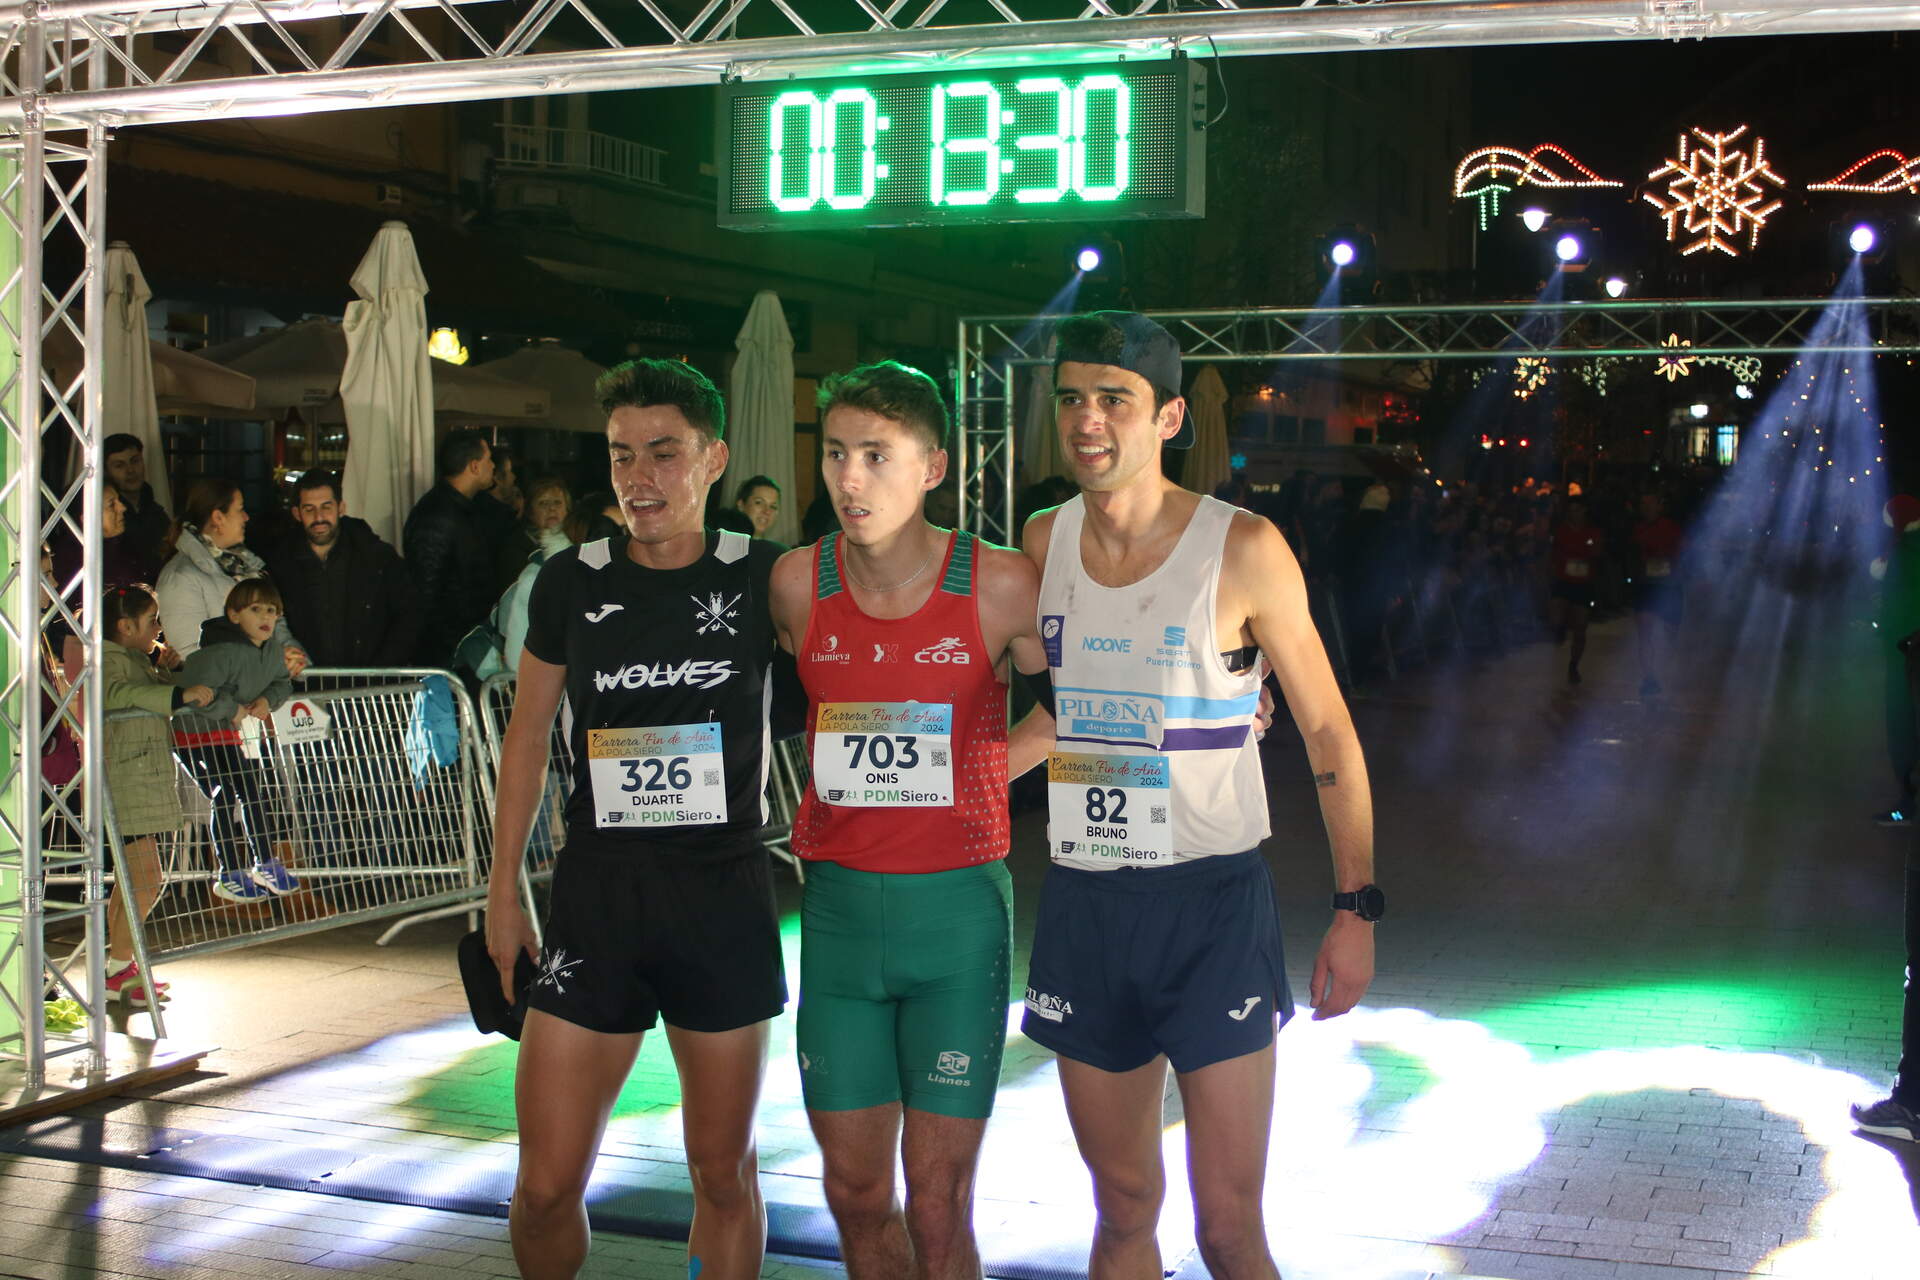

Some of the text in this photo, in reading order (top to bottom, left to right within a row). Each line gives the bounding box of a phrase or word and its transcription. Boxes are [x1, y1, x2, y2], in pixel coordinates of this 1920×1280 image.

[1082, 636, 1133, 653] NOONE
[1145, 657, 1174, 668] Puerta
[593, 659, 741, 693] WOLVES
[820, 708, 869, 722] Carrera
[871, 708, 893, 722] Fin
[895, 708, 911, 722] de
[819, 722, 890, 731] LA POLA SIERO
[920, 724, 945, 733] 2024
[1086, 723, 1132, 734] deporte
[592, 730, 715, 748] Carrera Fin de Año
[592, 746, 662, 757] LA POLA SIERO
[692, 744, 716, 752] 2024
[843, 734, 920, 770] 703
[1052, 757, 1162, 777] Carrera Fin de Año
[619, 756, 693, 792] 326
[865, 772, 899, 784] ONIS
[1052, 772, 1113, 784] LA POLA SIERO
[1140, 777, 1163, 786] 2024
[632, 794, 684, 806] DUARTE
[864, 790, 938, 802] PDMSiero
[1086, 787, 1128, 824] 82
[641, 810, 713, 823] PDMSiero
[1086, 826, 1128, 840] BRUNO
[1091, 843, 1158, 860] PDMSiero
[927, 1072, 971, 1087] Llanes
